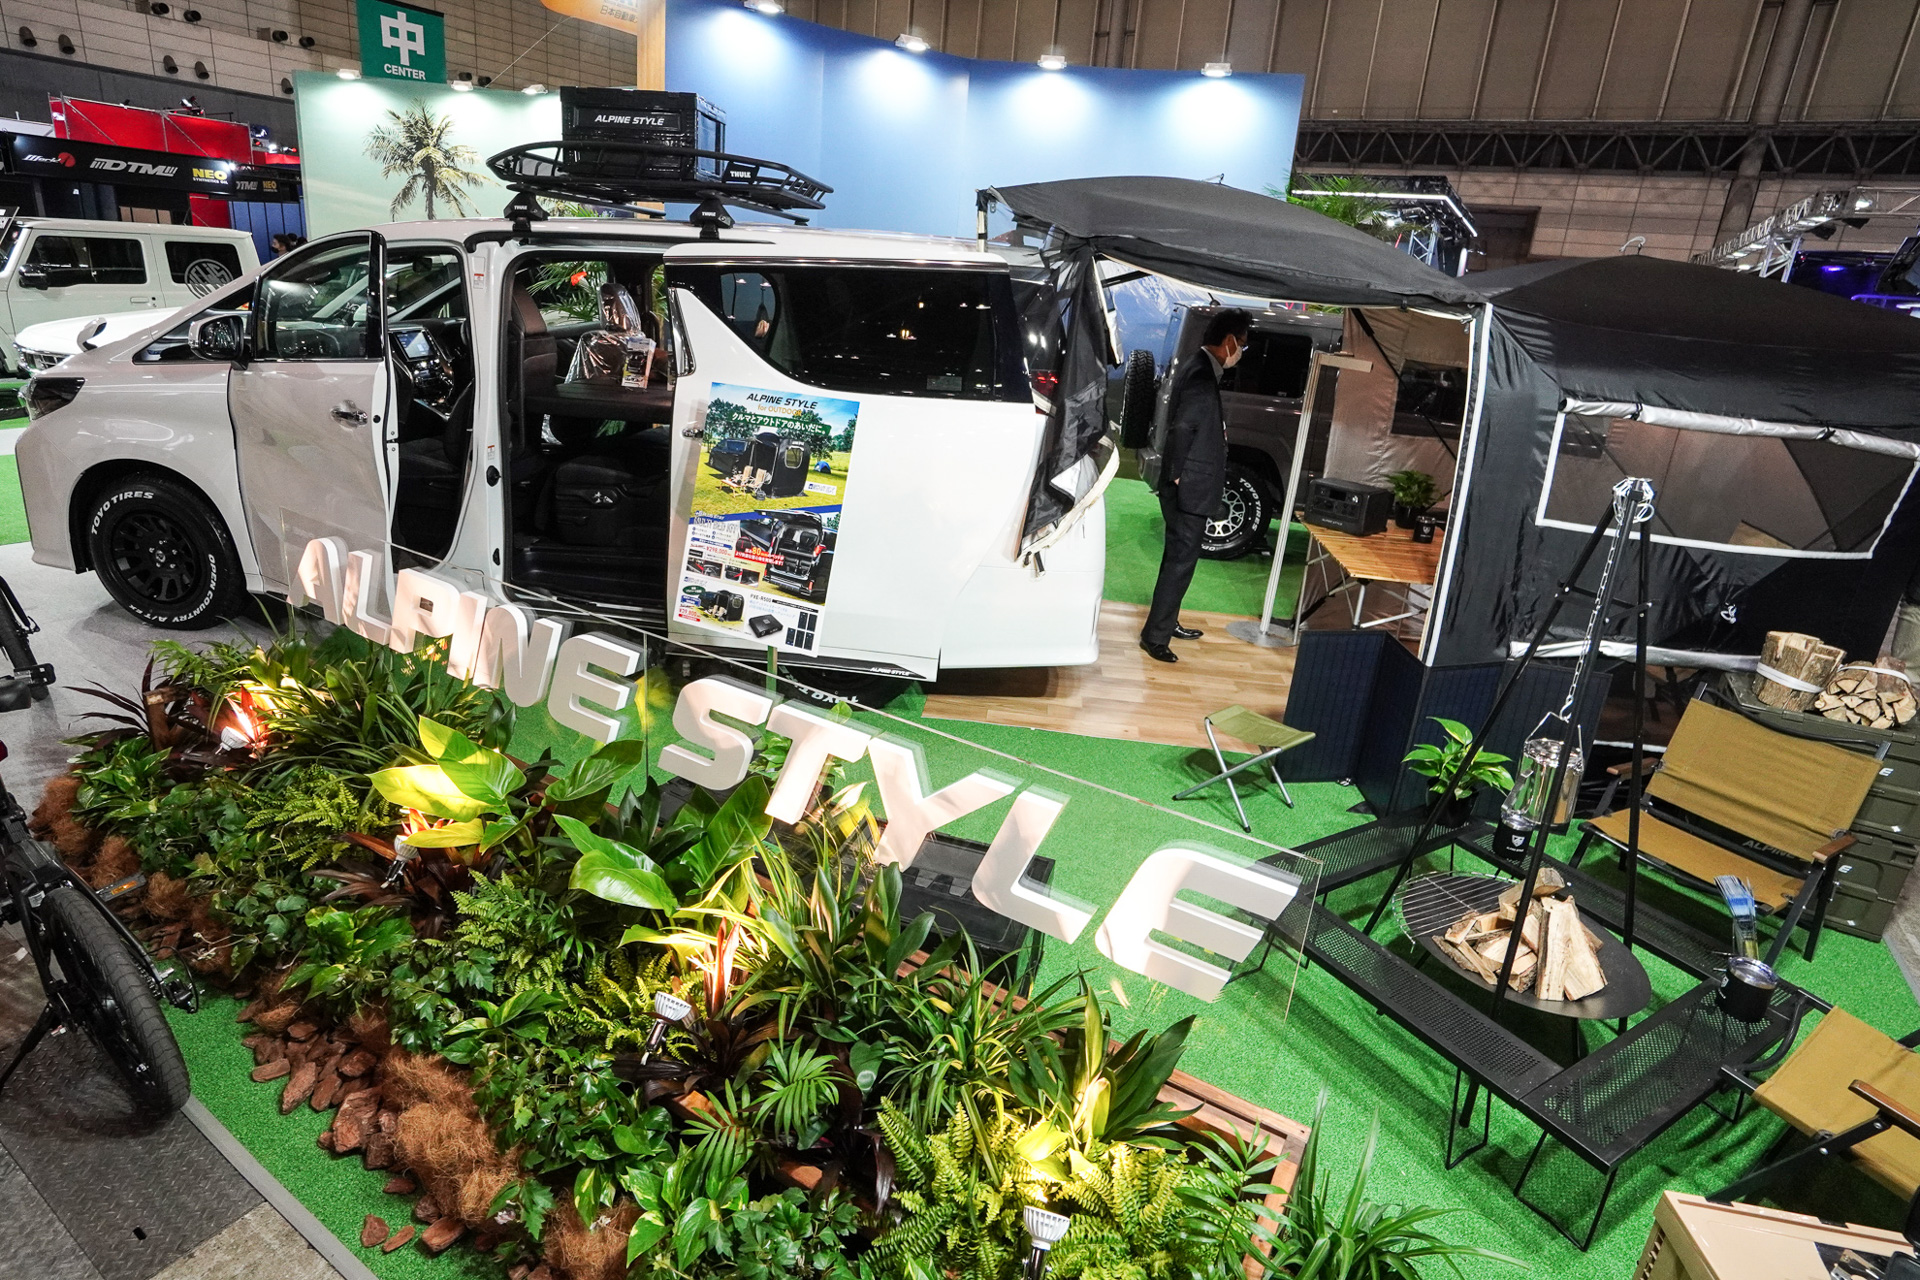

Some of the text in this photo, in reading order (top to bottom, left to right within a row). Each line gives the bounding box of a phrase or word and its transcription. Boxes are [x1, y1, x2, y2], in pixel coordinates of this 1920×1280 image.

[379, 10, 426, 67] 中
[383, 63, 426, 81] CENTER
[594, 114, 665, 126] ALPINE STYLE
[192, 167, 228, 181] NEO
[730, 170, 751, 179] THULE
[262, 180, 277, 189] NEO
[746, 393, 818, 410] ALPINE STYLE
[758, 404, 802, 416] for OUTDOOR
[732, 412, 826, 435] クルマとアウトドアのあいだに。
[91, 490, 154, 535] TOYO TIRES
[1239, 478, 1261, 531] TOYO TIRES
[208, 553, 217, 592] OPEN
[172, 590, 213, 623] COUNTRY
[286, 536, 1301, 1004] ALPINE STYLE
